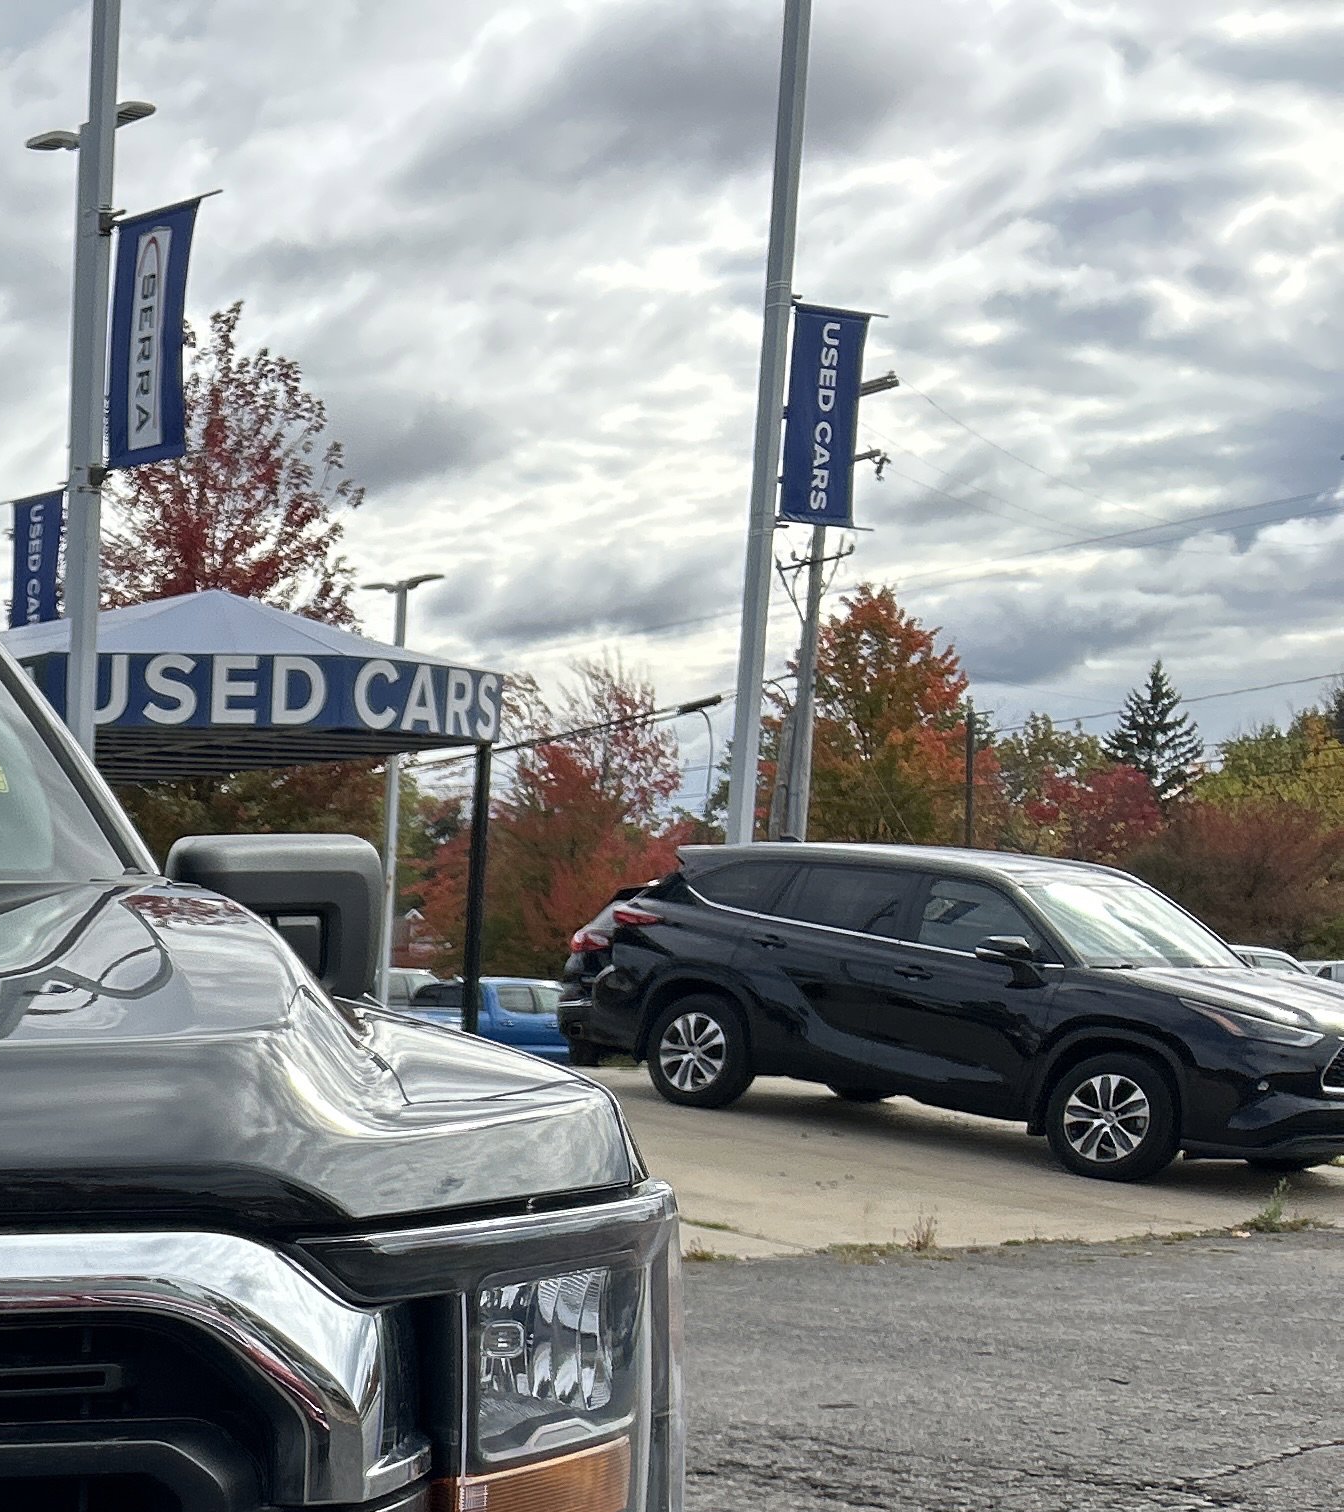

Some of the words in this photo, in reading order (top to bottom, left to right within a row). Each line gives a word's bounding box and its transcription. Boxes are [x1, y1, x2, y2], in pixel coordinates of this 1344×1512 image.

[135, 273, 156, 433] SERRA
[817, 322, 842, 412] USED
[809, 421, 834, 511] CARS
[27, 503, 45, 573] USED
[94, 653, 327, 726] USED
[354, 659, 498, 740] CARS
